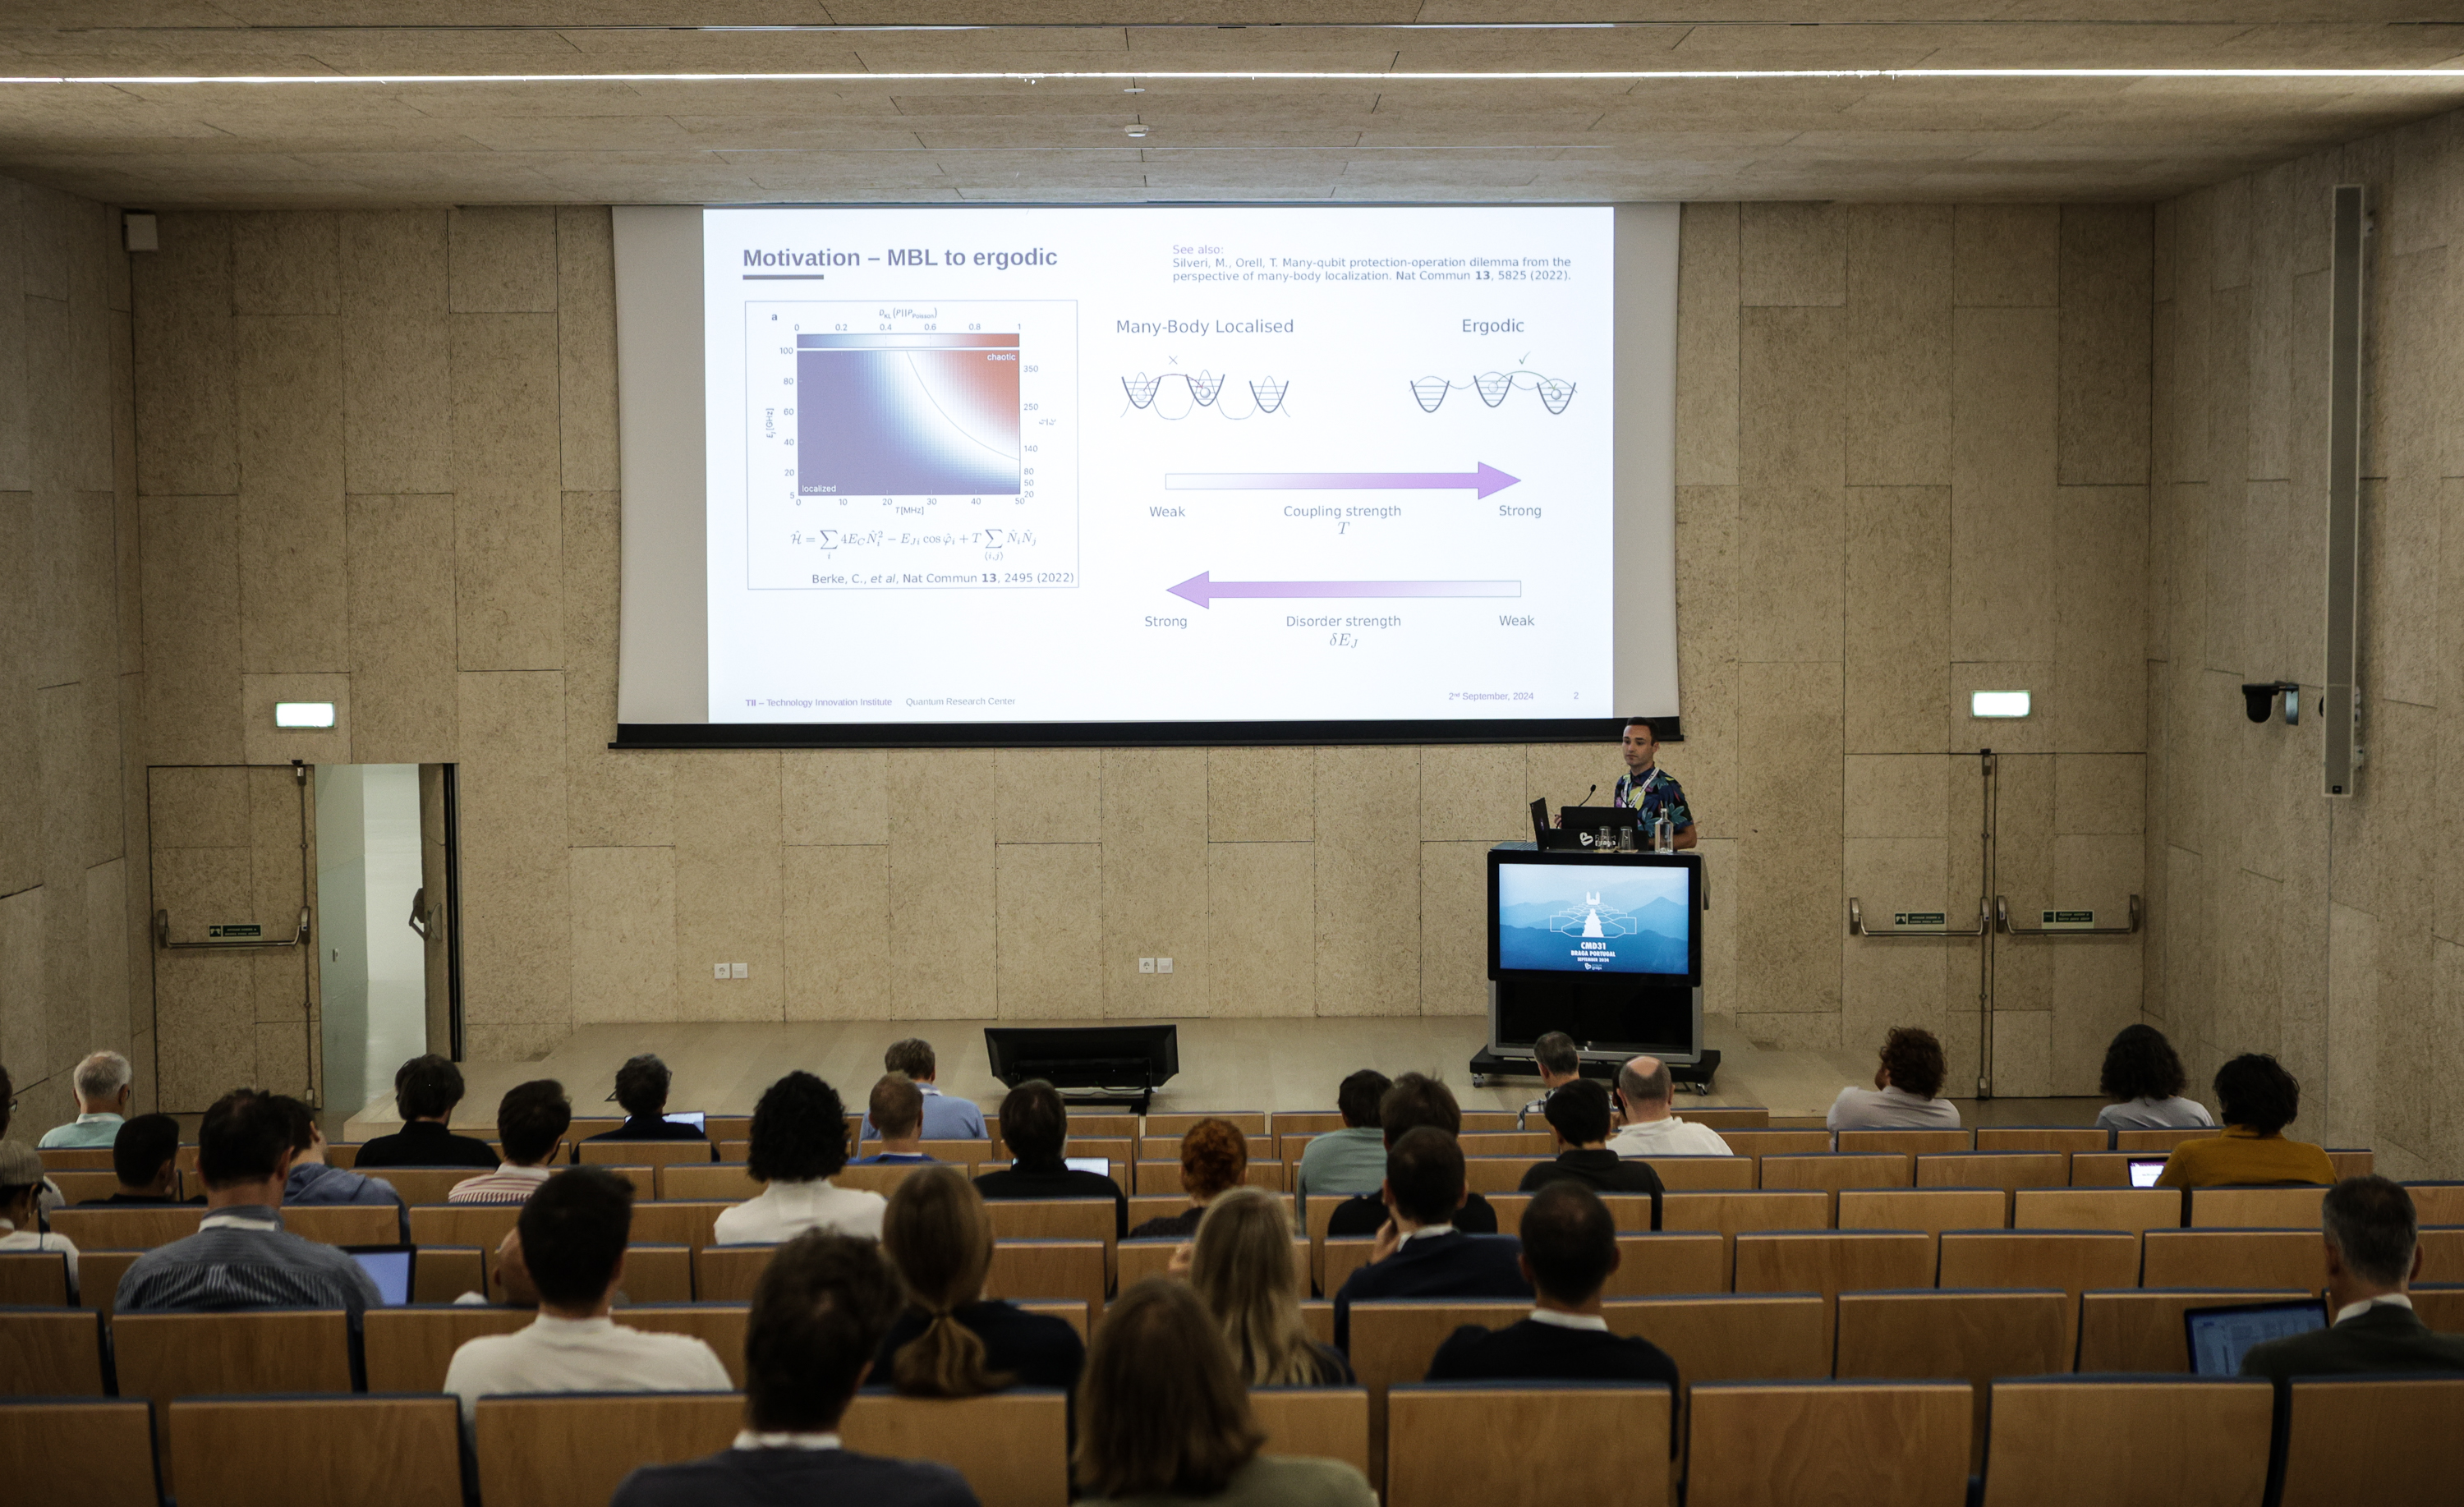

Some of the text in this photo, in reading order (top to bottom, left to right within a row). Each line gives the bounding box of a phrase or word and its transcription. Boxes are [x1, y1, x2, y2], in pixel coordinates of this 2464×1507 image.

[1172, 244, 1224, 255] See also:
[743, 247, 861, 267] Motivation
[887, 248, 939, 266] MBL
[944, 249, 966, 266] to
[972, 247, 1058, 271] ergodic
[1173, 256, 1572, 270] Silveri, M., Orell, T. Many-qubit protection-operation dilemma from the
[1173, 269, 1571, 283] perspective of many-body localization. Nat Commun 13, 5825 (2022).
[793, 323, 1022, 332] 0 0.2 0.4 0.6 0.8 1
[1116, 319, 1294, 337] Many-Body Localised
[1462, 318, 1524, 336] Ergodic
[779, 347, 794, 356] 100
[986, 352, 1016, 361] chaotic
[1023, 365, 1039, 374] 350
[783, 377, 794, 386] 80
[783, 407, 795, 416] 60
[1023, 402, 1039, 411] 250
[784, 438, 795, 447] 40
[1023, 444, 1038, 453] 140
[784, 468, 795, 477] 20
[1023, 466, 1035, 476] 80
[1023, 478, 1035, 487] 50
[802, 485, 837, 493] localized
[1023, 489, 1035, 499] 20
[789, 491, 795, 500] 5
[795, 497, 1025, 507] 0 10 20 30 40 50
[1149, 505, 1186, 517] Weak
[1284, 504, 1402, 520] Coupling strength
[1499, 504, 1542, 519] Strong
[811, 572, 1074, 585] Berke, C., et al, Nat Commun 13, 2495 (2022)
[1144, 615, 1188, 630] Strong
[1286, 614, 1401, 630] Disorder strength
[1498, 614, 1535, 627] Weak
[1462, 691, 1510, 702] September,
[1513, 691, 1534, 701] 2024
[1573, 691, 1579, 701] 2
[765, 698, 813, 709] Technology
[815, 697, 858, 706] Innovation
[860, 697, 893, 706] Institute
[905, 696, 1016, 708] Quantum Research Center
[1580, 941, 1607, 950] CMD31
